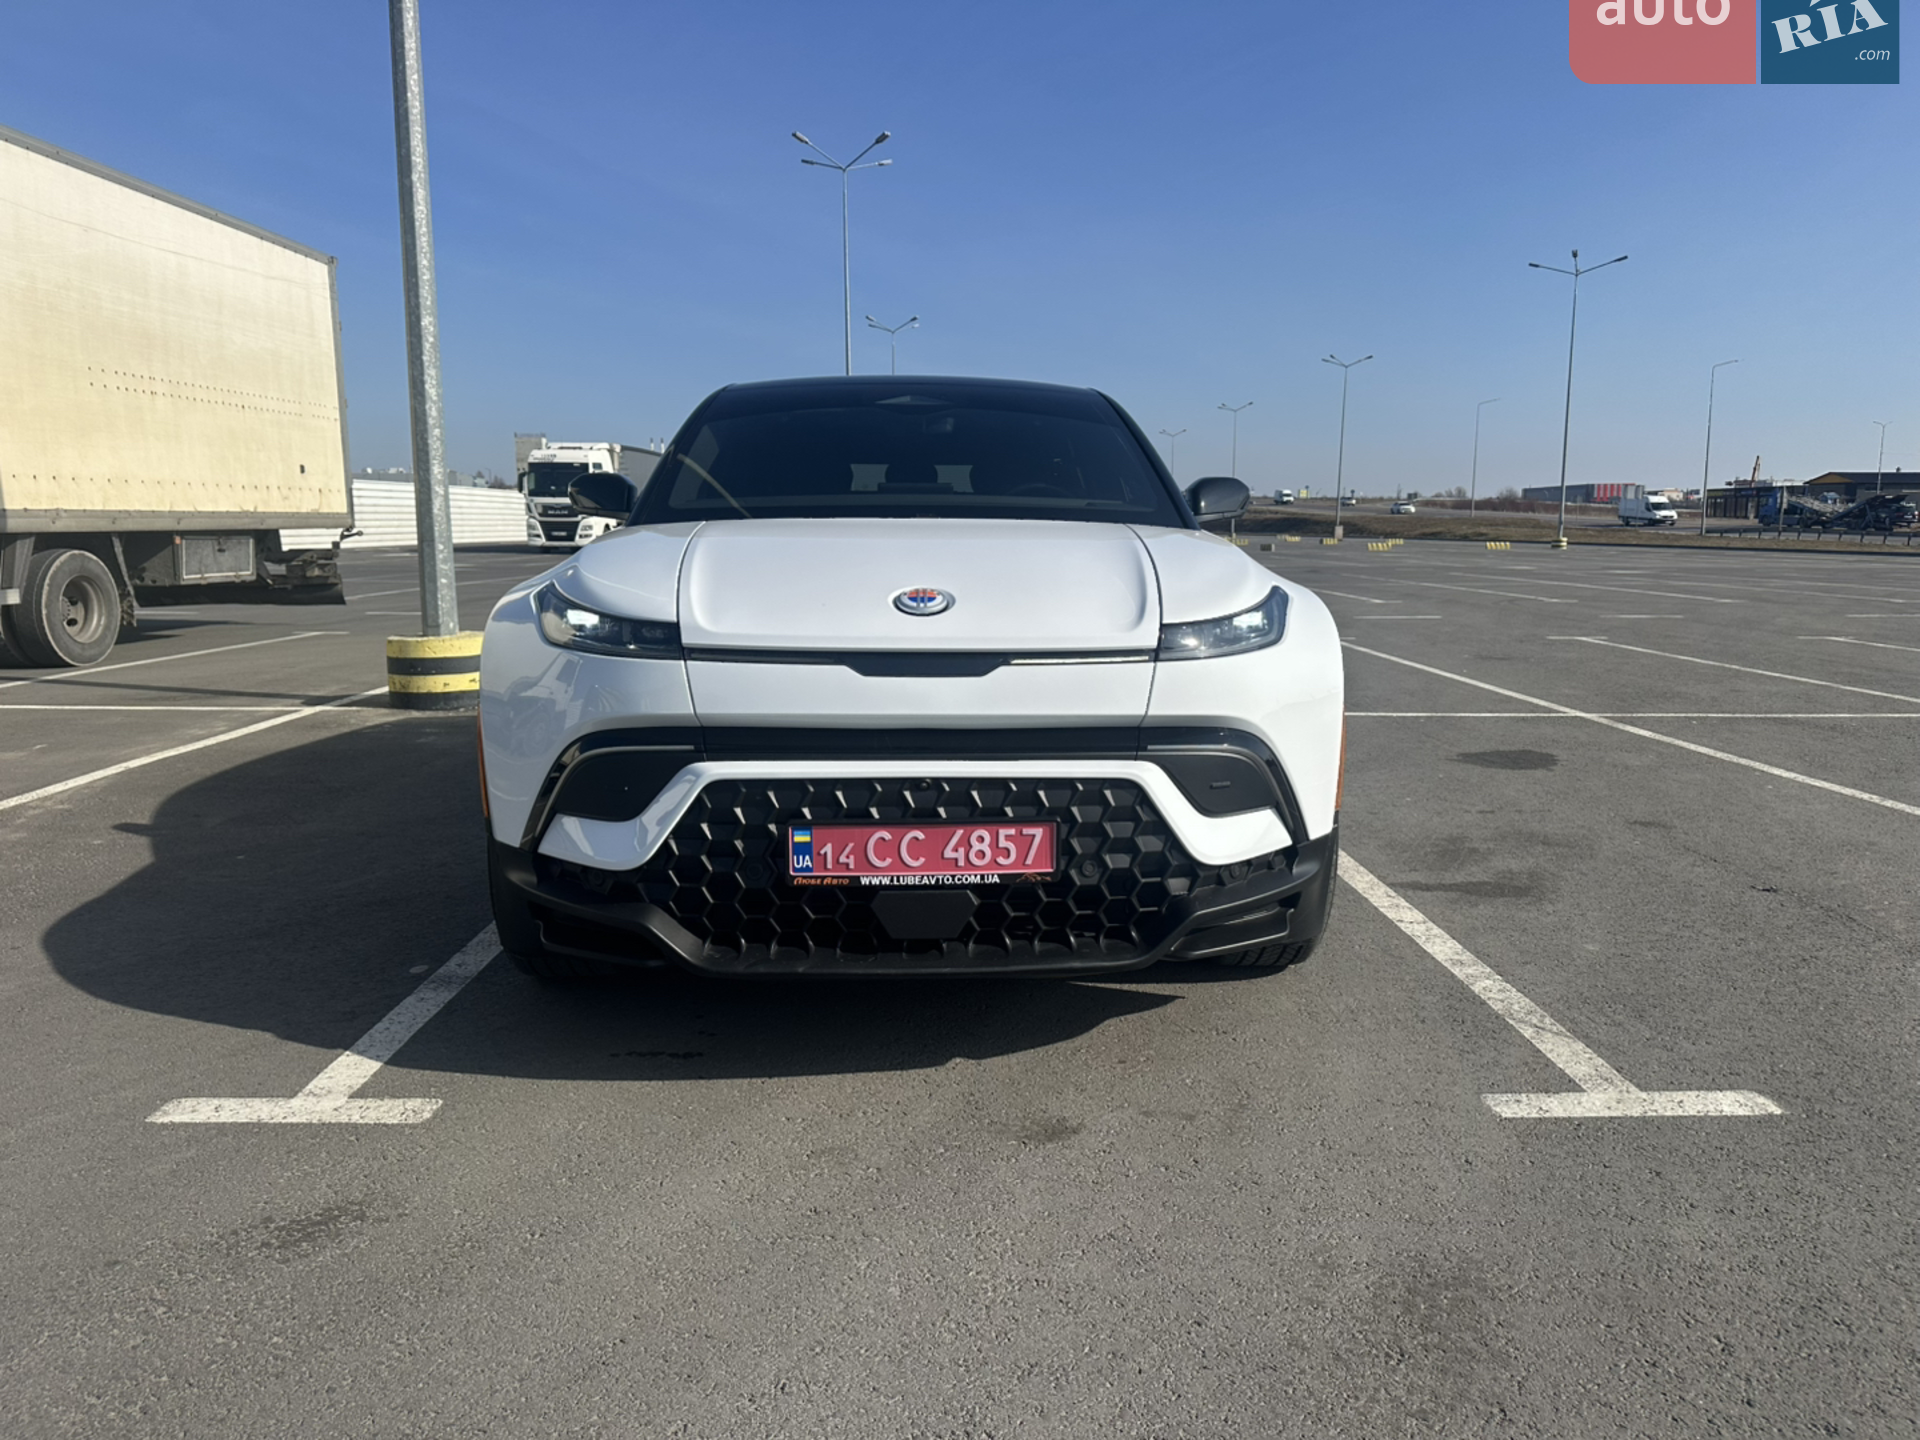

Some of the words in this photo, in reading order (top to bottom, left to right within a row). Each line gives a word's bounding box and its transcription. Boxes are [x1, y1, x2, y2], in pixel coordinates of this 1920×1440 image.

[819, 842, 855, 869] 14
[866, 830, 926, 868] CC
[942, 828, 1044, 867] 4857
[793, 855, 813, 869] UA
[860, 874, 1000, 885] WWW.LUBEAVTO.COM.UA
